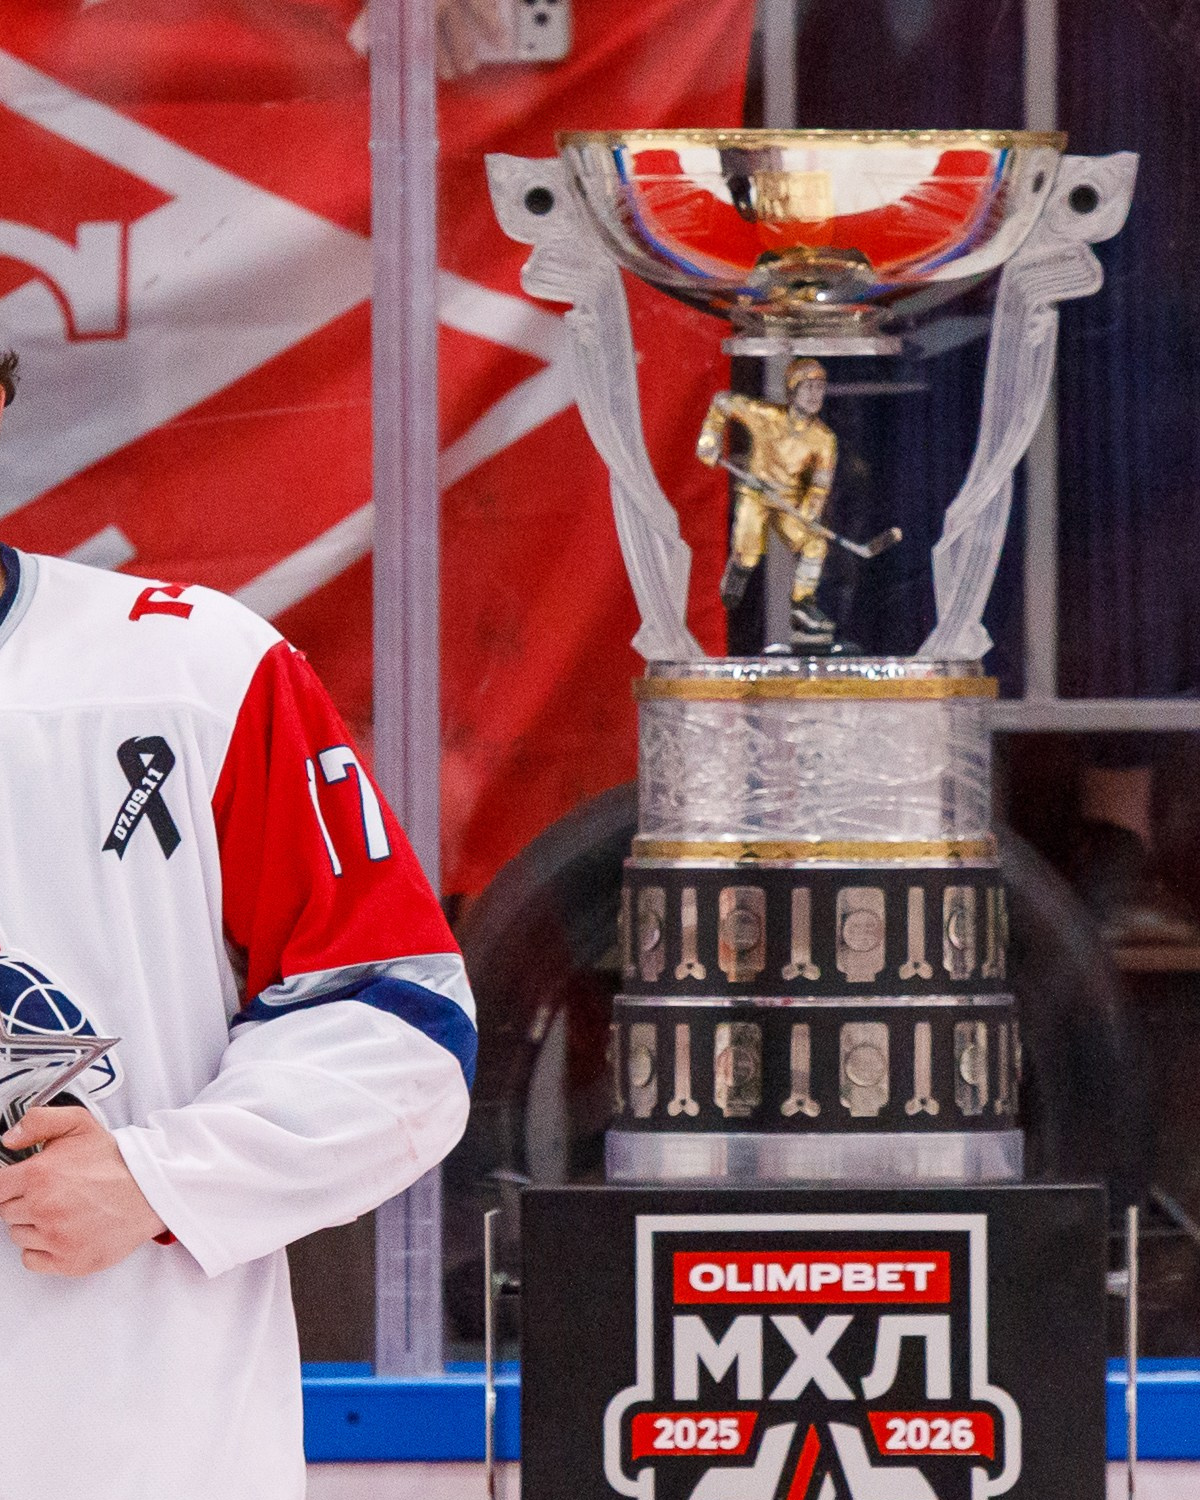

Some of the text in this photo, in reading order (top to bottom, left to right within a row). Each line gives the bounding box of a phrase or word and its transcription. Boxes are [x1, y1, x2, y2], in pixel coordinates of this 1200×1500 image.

[113, 767, 165, 841] 07.09.11
[688, 1262, 937, 1292] OLIMPBET
[673, 1314, 952, 1401] МХЛ
[652, 1418, 742, 1451] 2025
[885, 1417, 976, 1451] 2026
